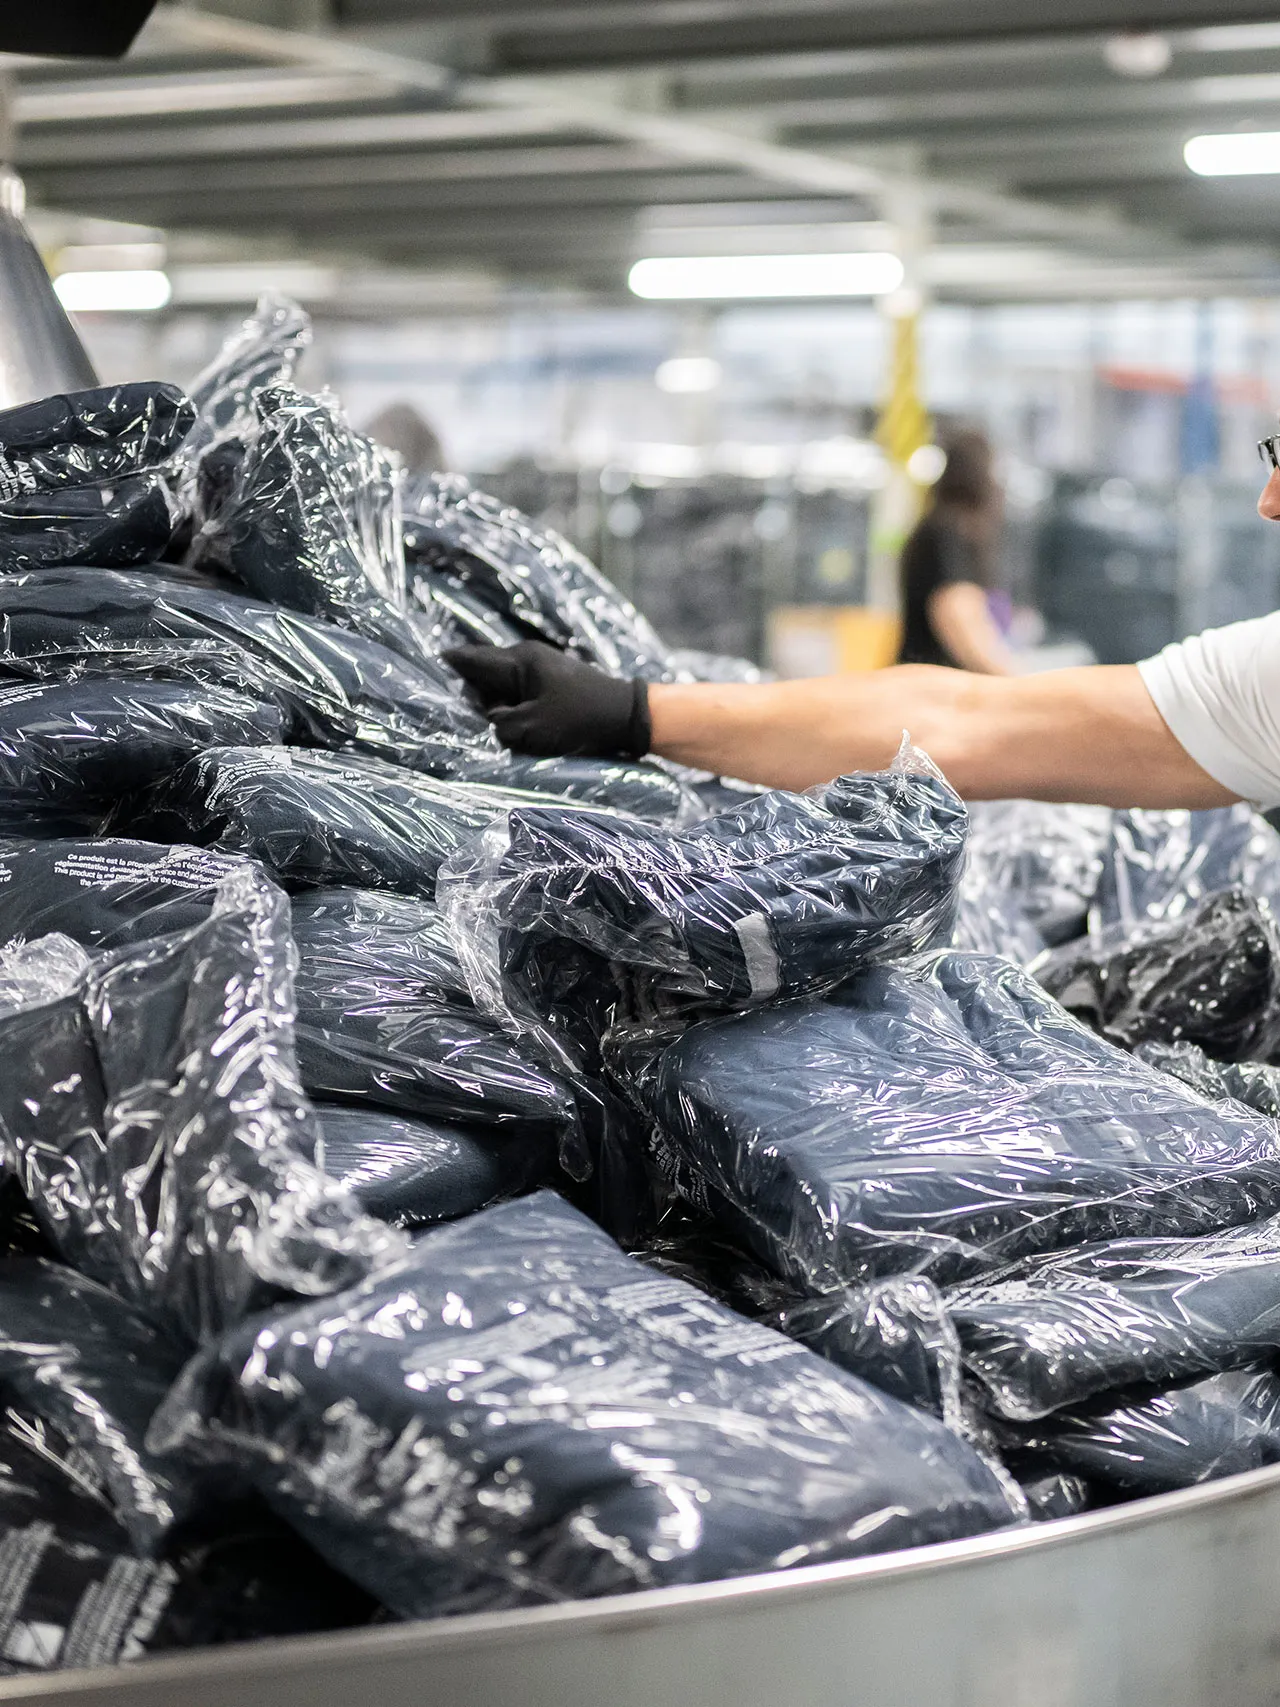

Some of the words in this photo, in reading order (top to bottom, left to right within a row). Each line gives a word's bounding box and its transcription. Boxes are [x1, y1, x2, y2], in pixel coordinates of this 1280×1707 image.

[78, 855, 105, 863] produit
[119, 858, 126, 866] la
[54, 866, 69, 875] This
[69, 869, 96, 879] product
[96, 871, 103, 880] is
[177, 870, 190, 879] and
[80, 878, 92, 887] the
[160, 877, 172, 885] the
[171, 879, 199, 889] customs
